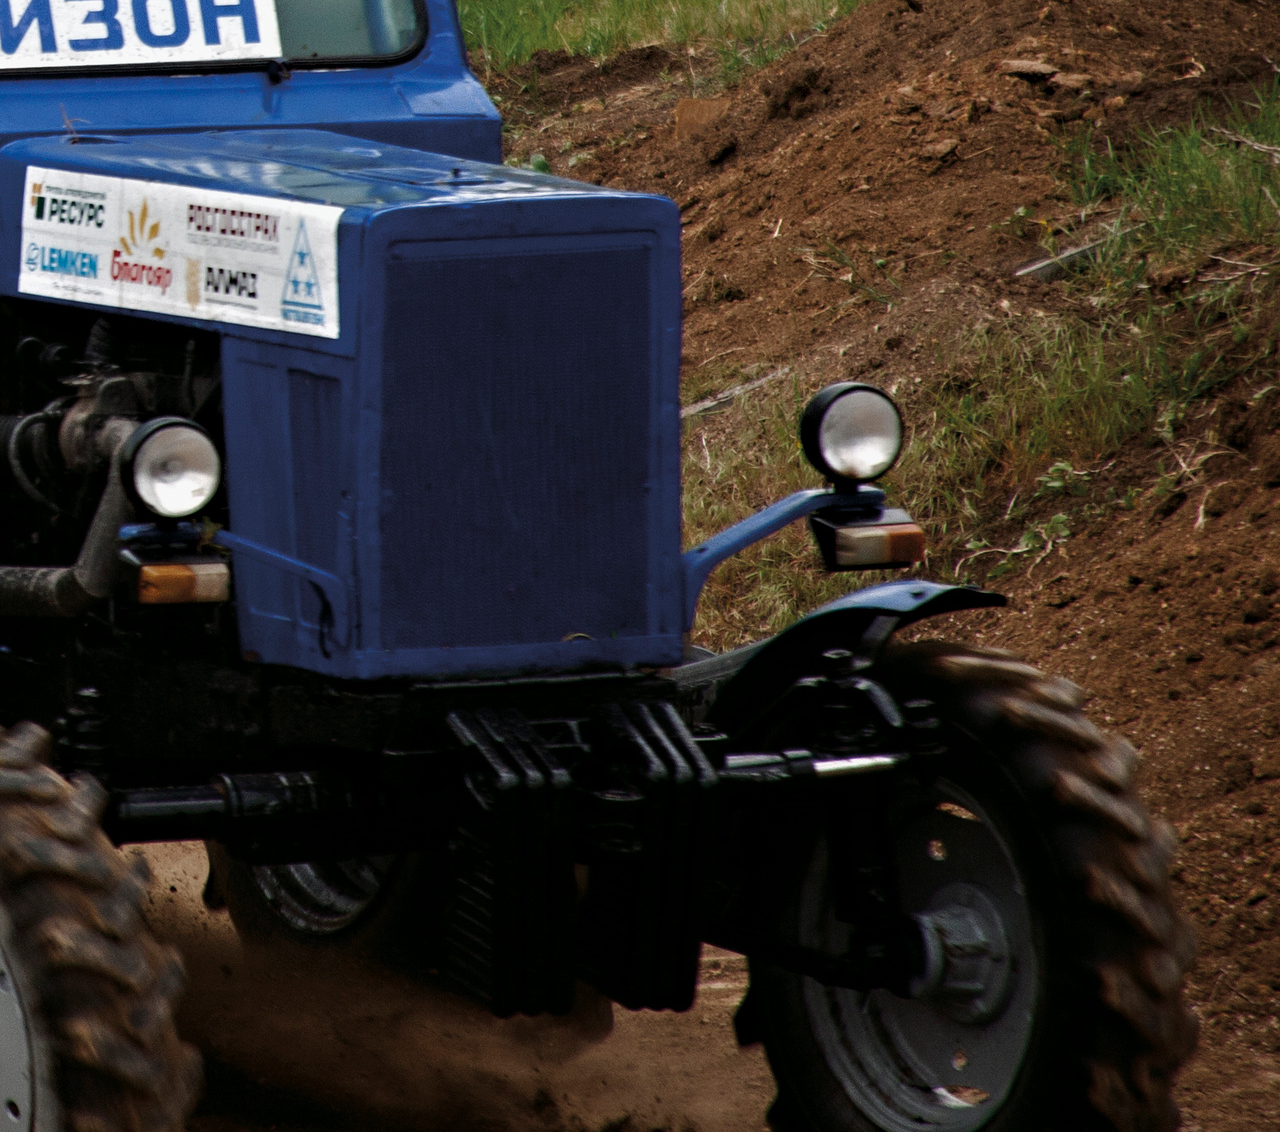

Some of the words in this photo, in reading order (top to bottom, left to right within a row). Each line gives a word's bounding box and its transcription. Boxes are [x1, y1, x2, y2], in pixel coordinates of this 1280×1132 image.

[48, 197, 106, 228] РЕСУРС
[41, 246, 98, 279] LEMKEN
[205, 266, 258, 300] АЛМАЗ
